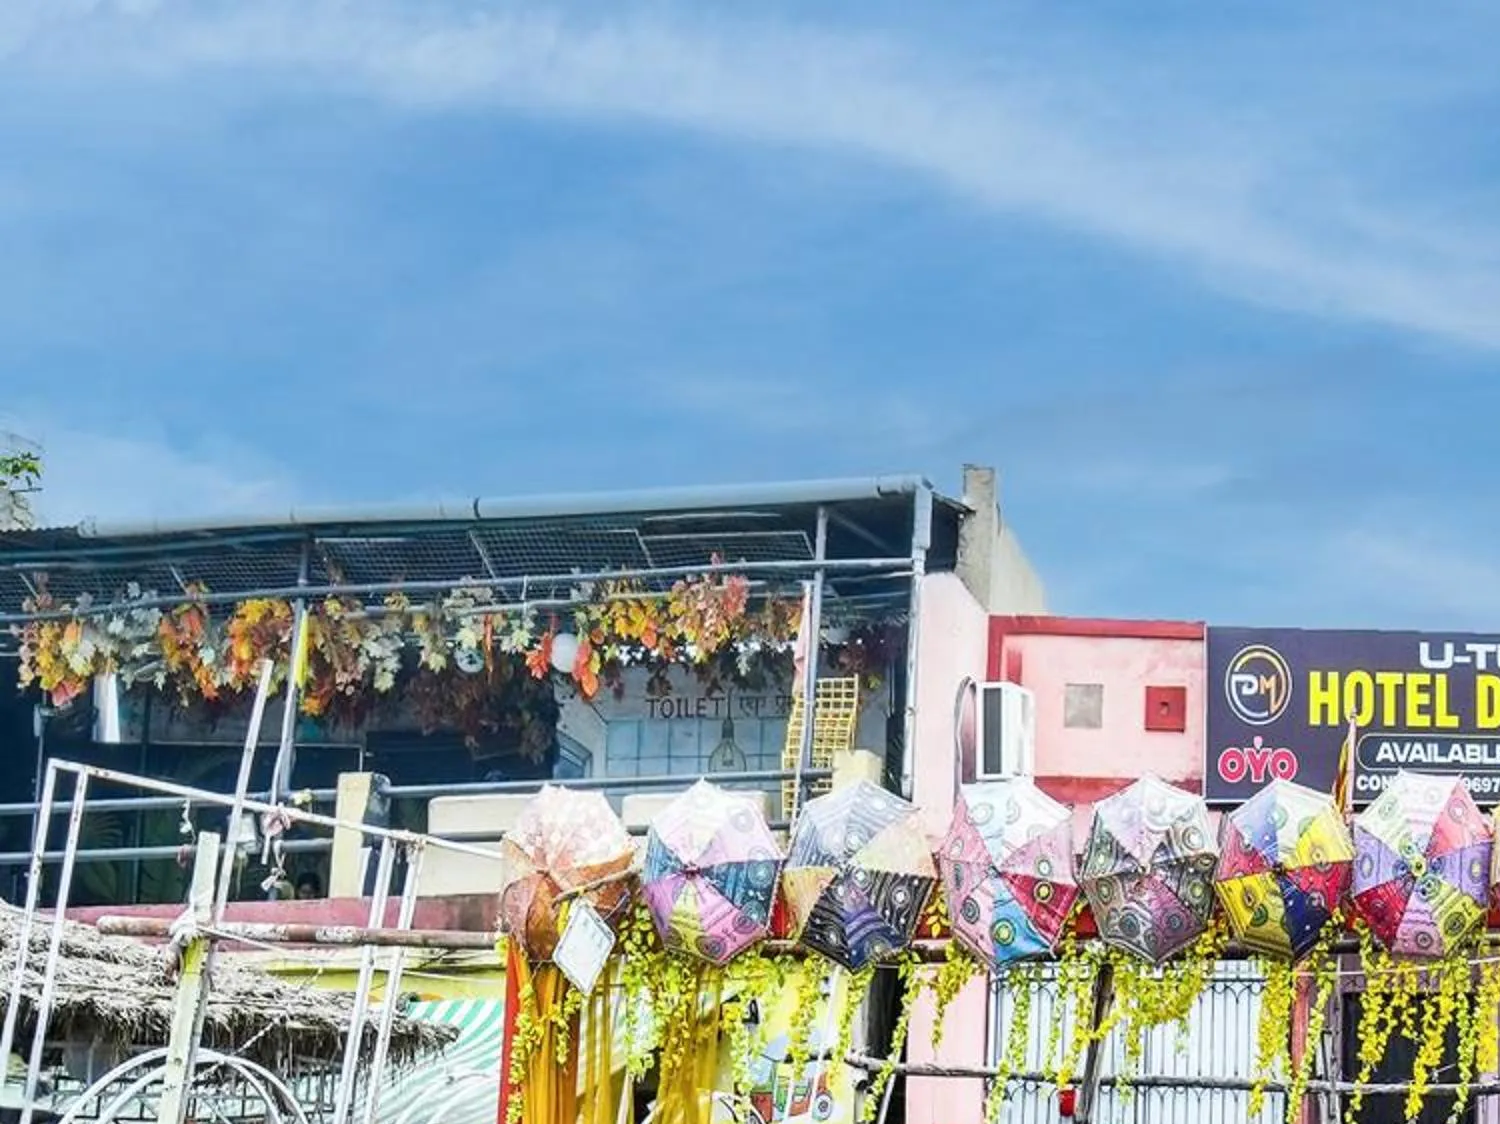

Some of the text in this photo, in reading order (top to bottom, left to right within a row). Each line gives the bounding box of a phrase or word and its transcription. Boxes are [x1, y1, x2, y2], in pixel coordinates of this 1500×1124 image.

[645, 697, 725, 718] TOILET
[1308, 670, 1459, 729] HOTEL
[1218, 746, 1298, 783] OYO
